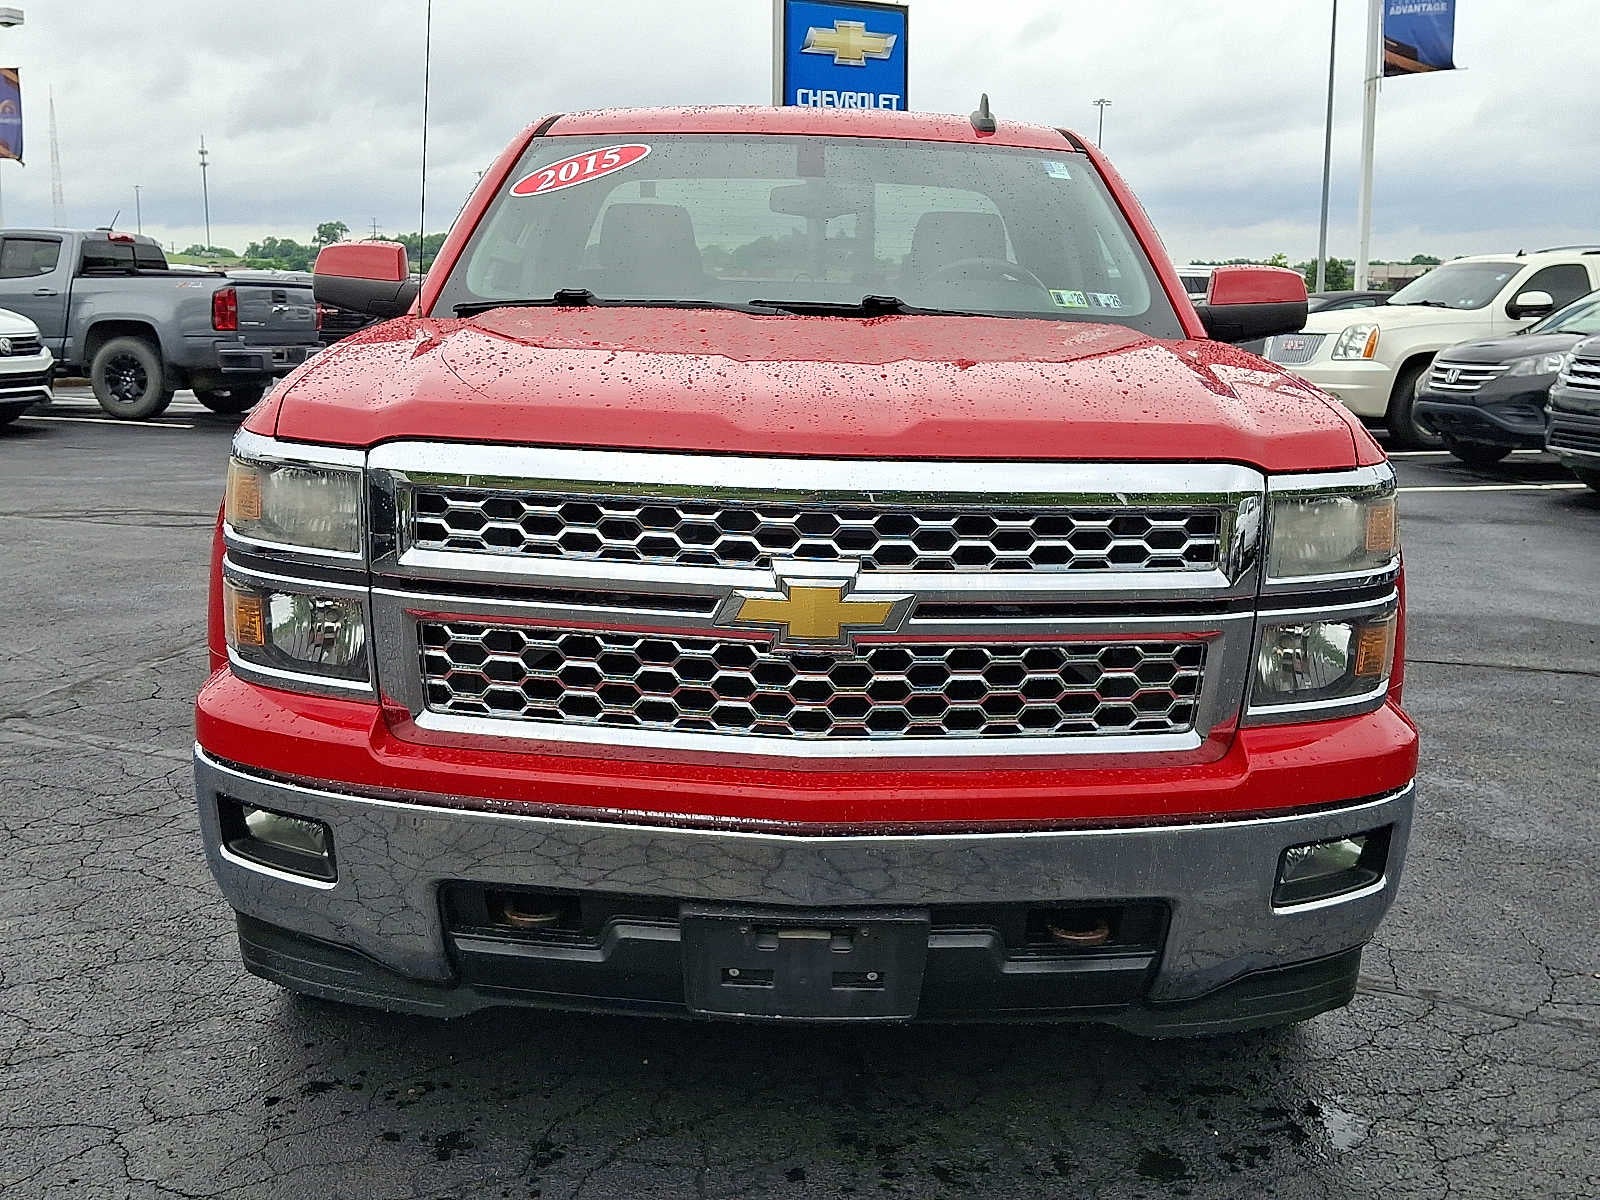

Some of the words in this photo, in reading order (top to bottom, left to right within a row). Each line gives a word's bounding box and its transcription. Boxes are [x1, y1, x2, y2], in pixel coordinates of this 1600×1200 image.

[1389, 3, 1448, 16] ADVANTAGE
[796, 88, 900, 111] CHEVROLET
[536, 148, 621, 191] 2015
